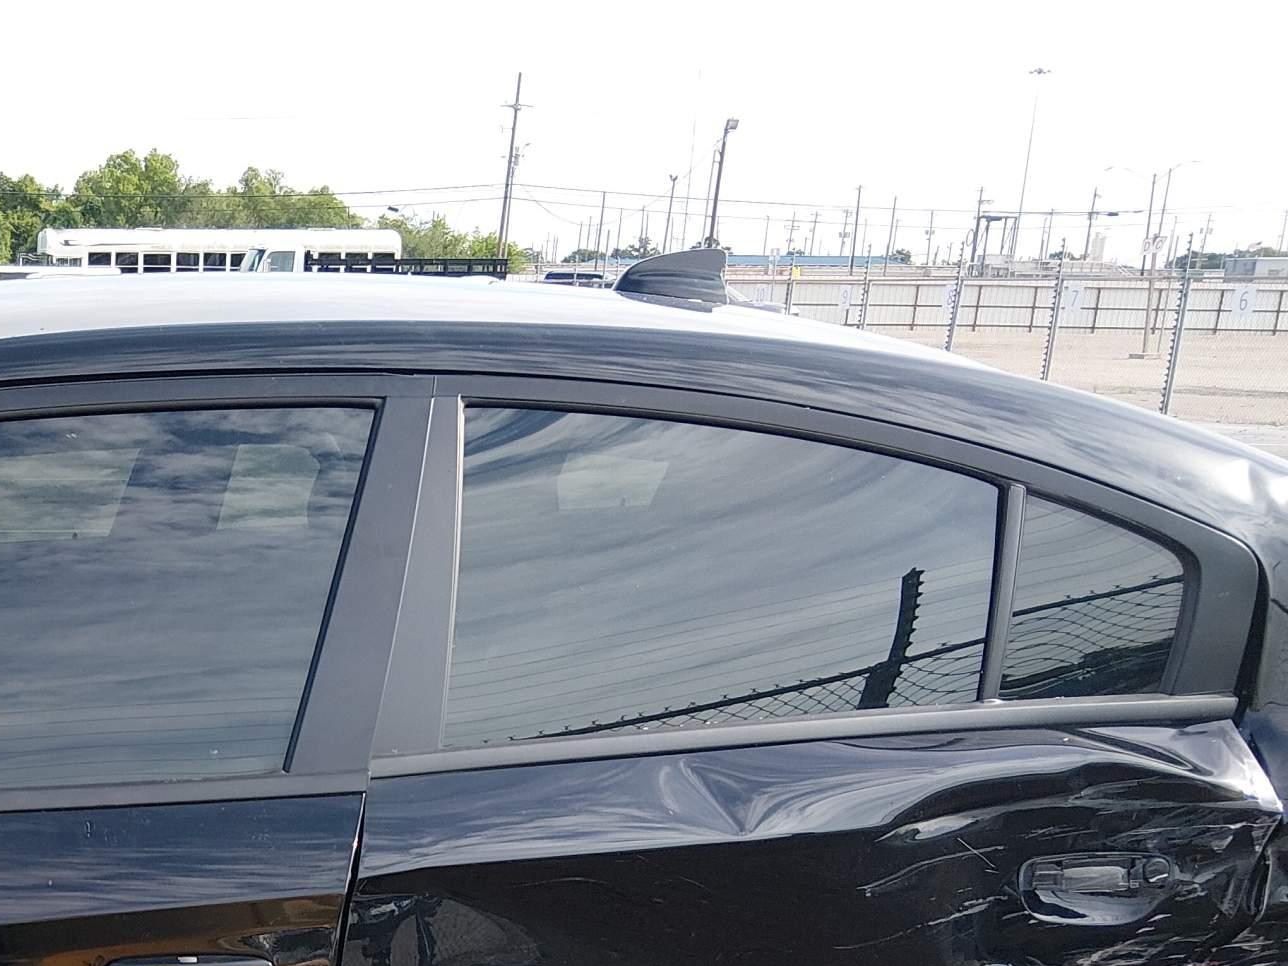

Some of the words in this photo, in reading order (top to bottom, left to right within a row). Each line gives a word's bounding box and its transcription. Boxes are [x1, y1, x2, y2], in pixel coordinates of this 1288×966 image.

[842, 289, 849, 304] 9
[1071, 290, 1079, 307] 7
[1239, 291, 1249, 311] 6
